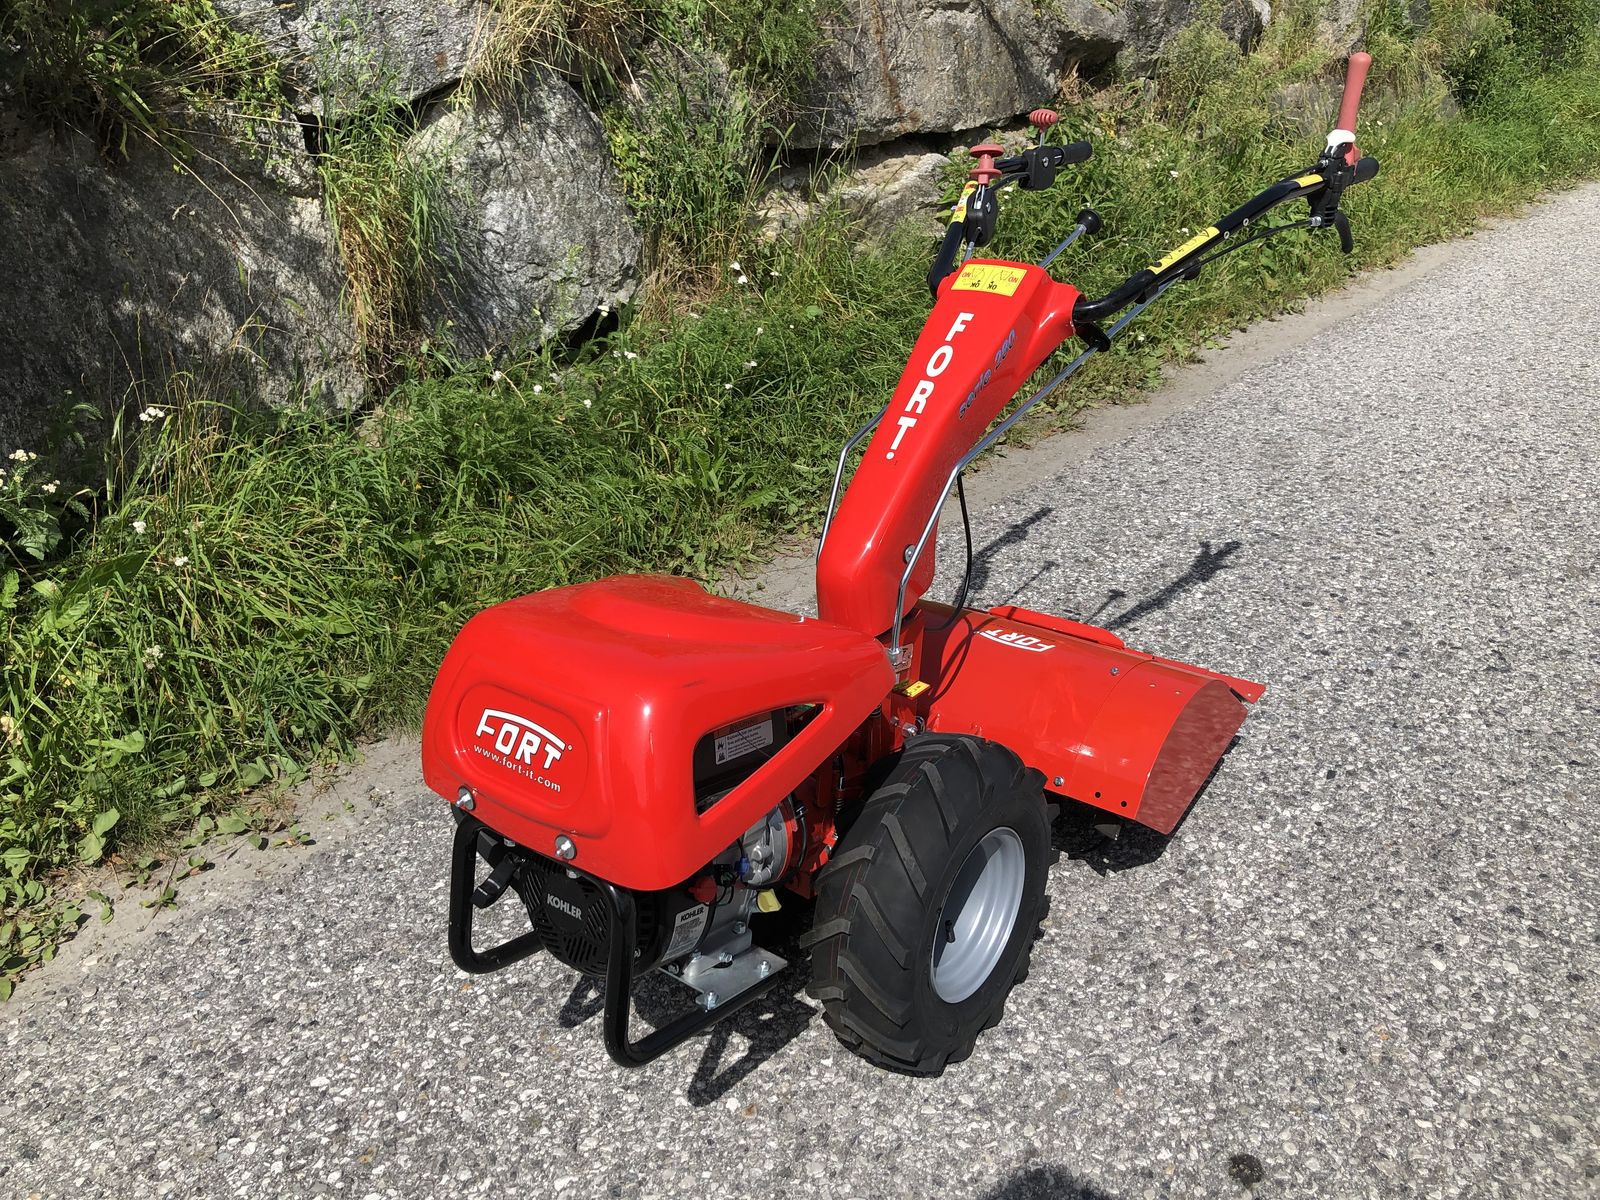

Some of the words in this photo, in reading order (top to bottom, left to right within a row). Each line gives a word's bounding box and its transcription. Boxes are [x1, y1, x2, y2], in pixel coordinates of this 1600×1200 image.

[889, 312, 975, 450] FORT
[980, 629, 1056, 652] FORT
[476, 708, 566, 769] FORT
[474, 745, 561, 792] www.fort-it.com
[547, 893, 582, 920] KOHLER
[681, 906, 704, 922] KOHLER
